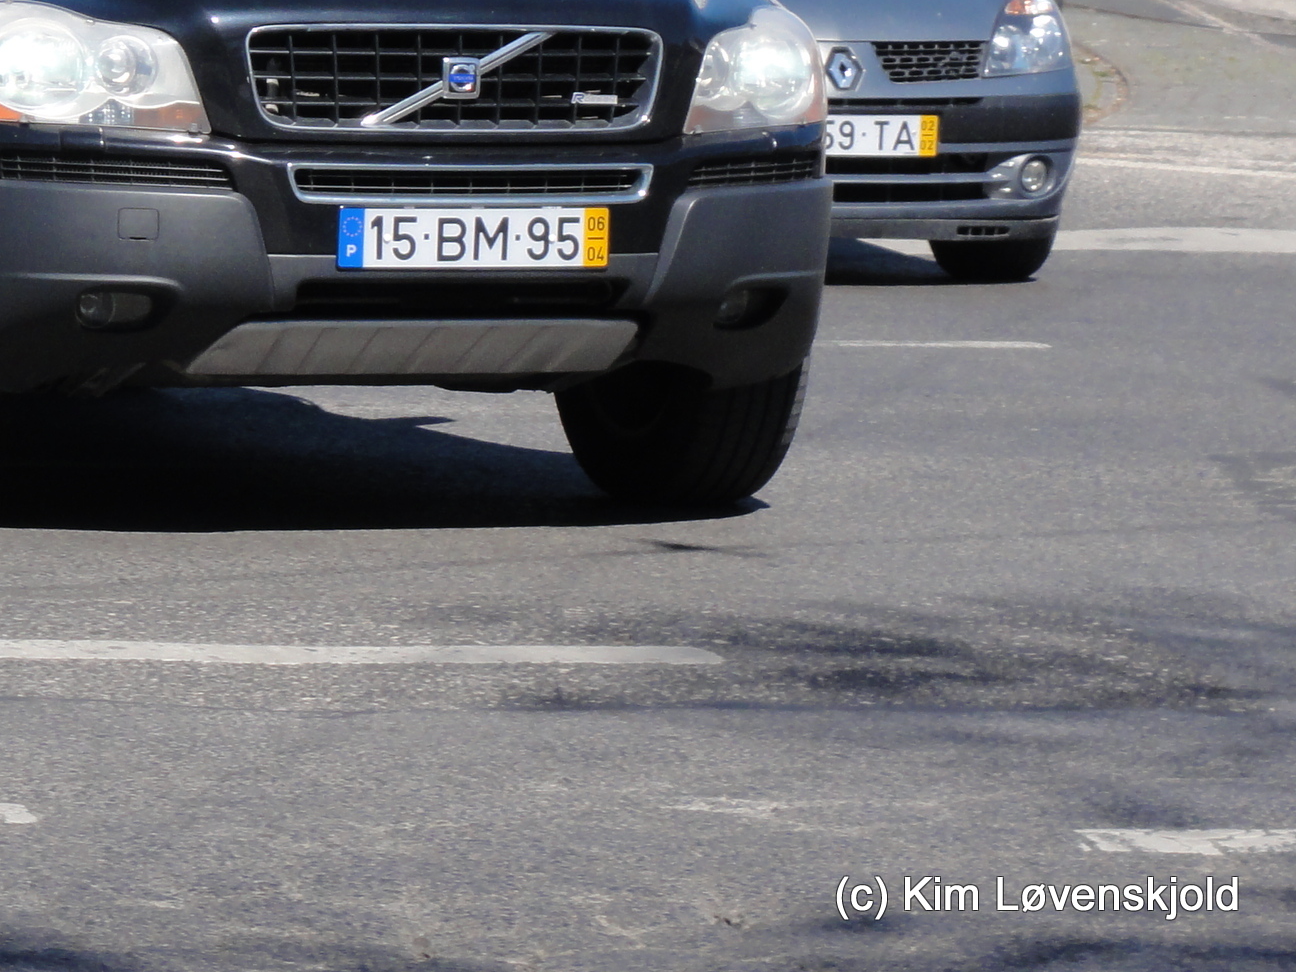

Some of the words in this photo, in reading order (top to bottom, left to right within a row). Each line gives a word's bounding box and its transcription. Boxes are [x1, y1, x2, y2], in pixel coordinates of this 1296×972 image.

[588, 216, 605, 232] 06
[346, 244, 357, 257] P
[587, 245, 604, 262] 04
